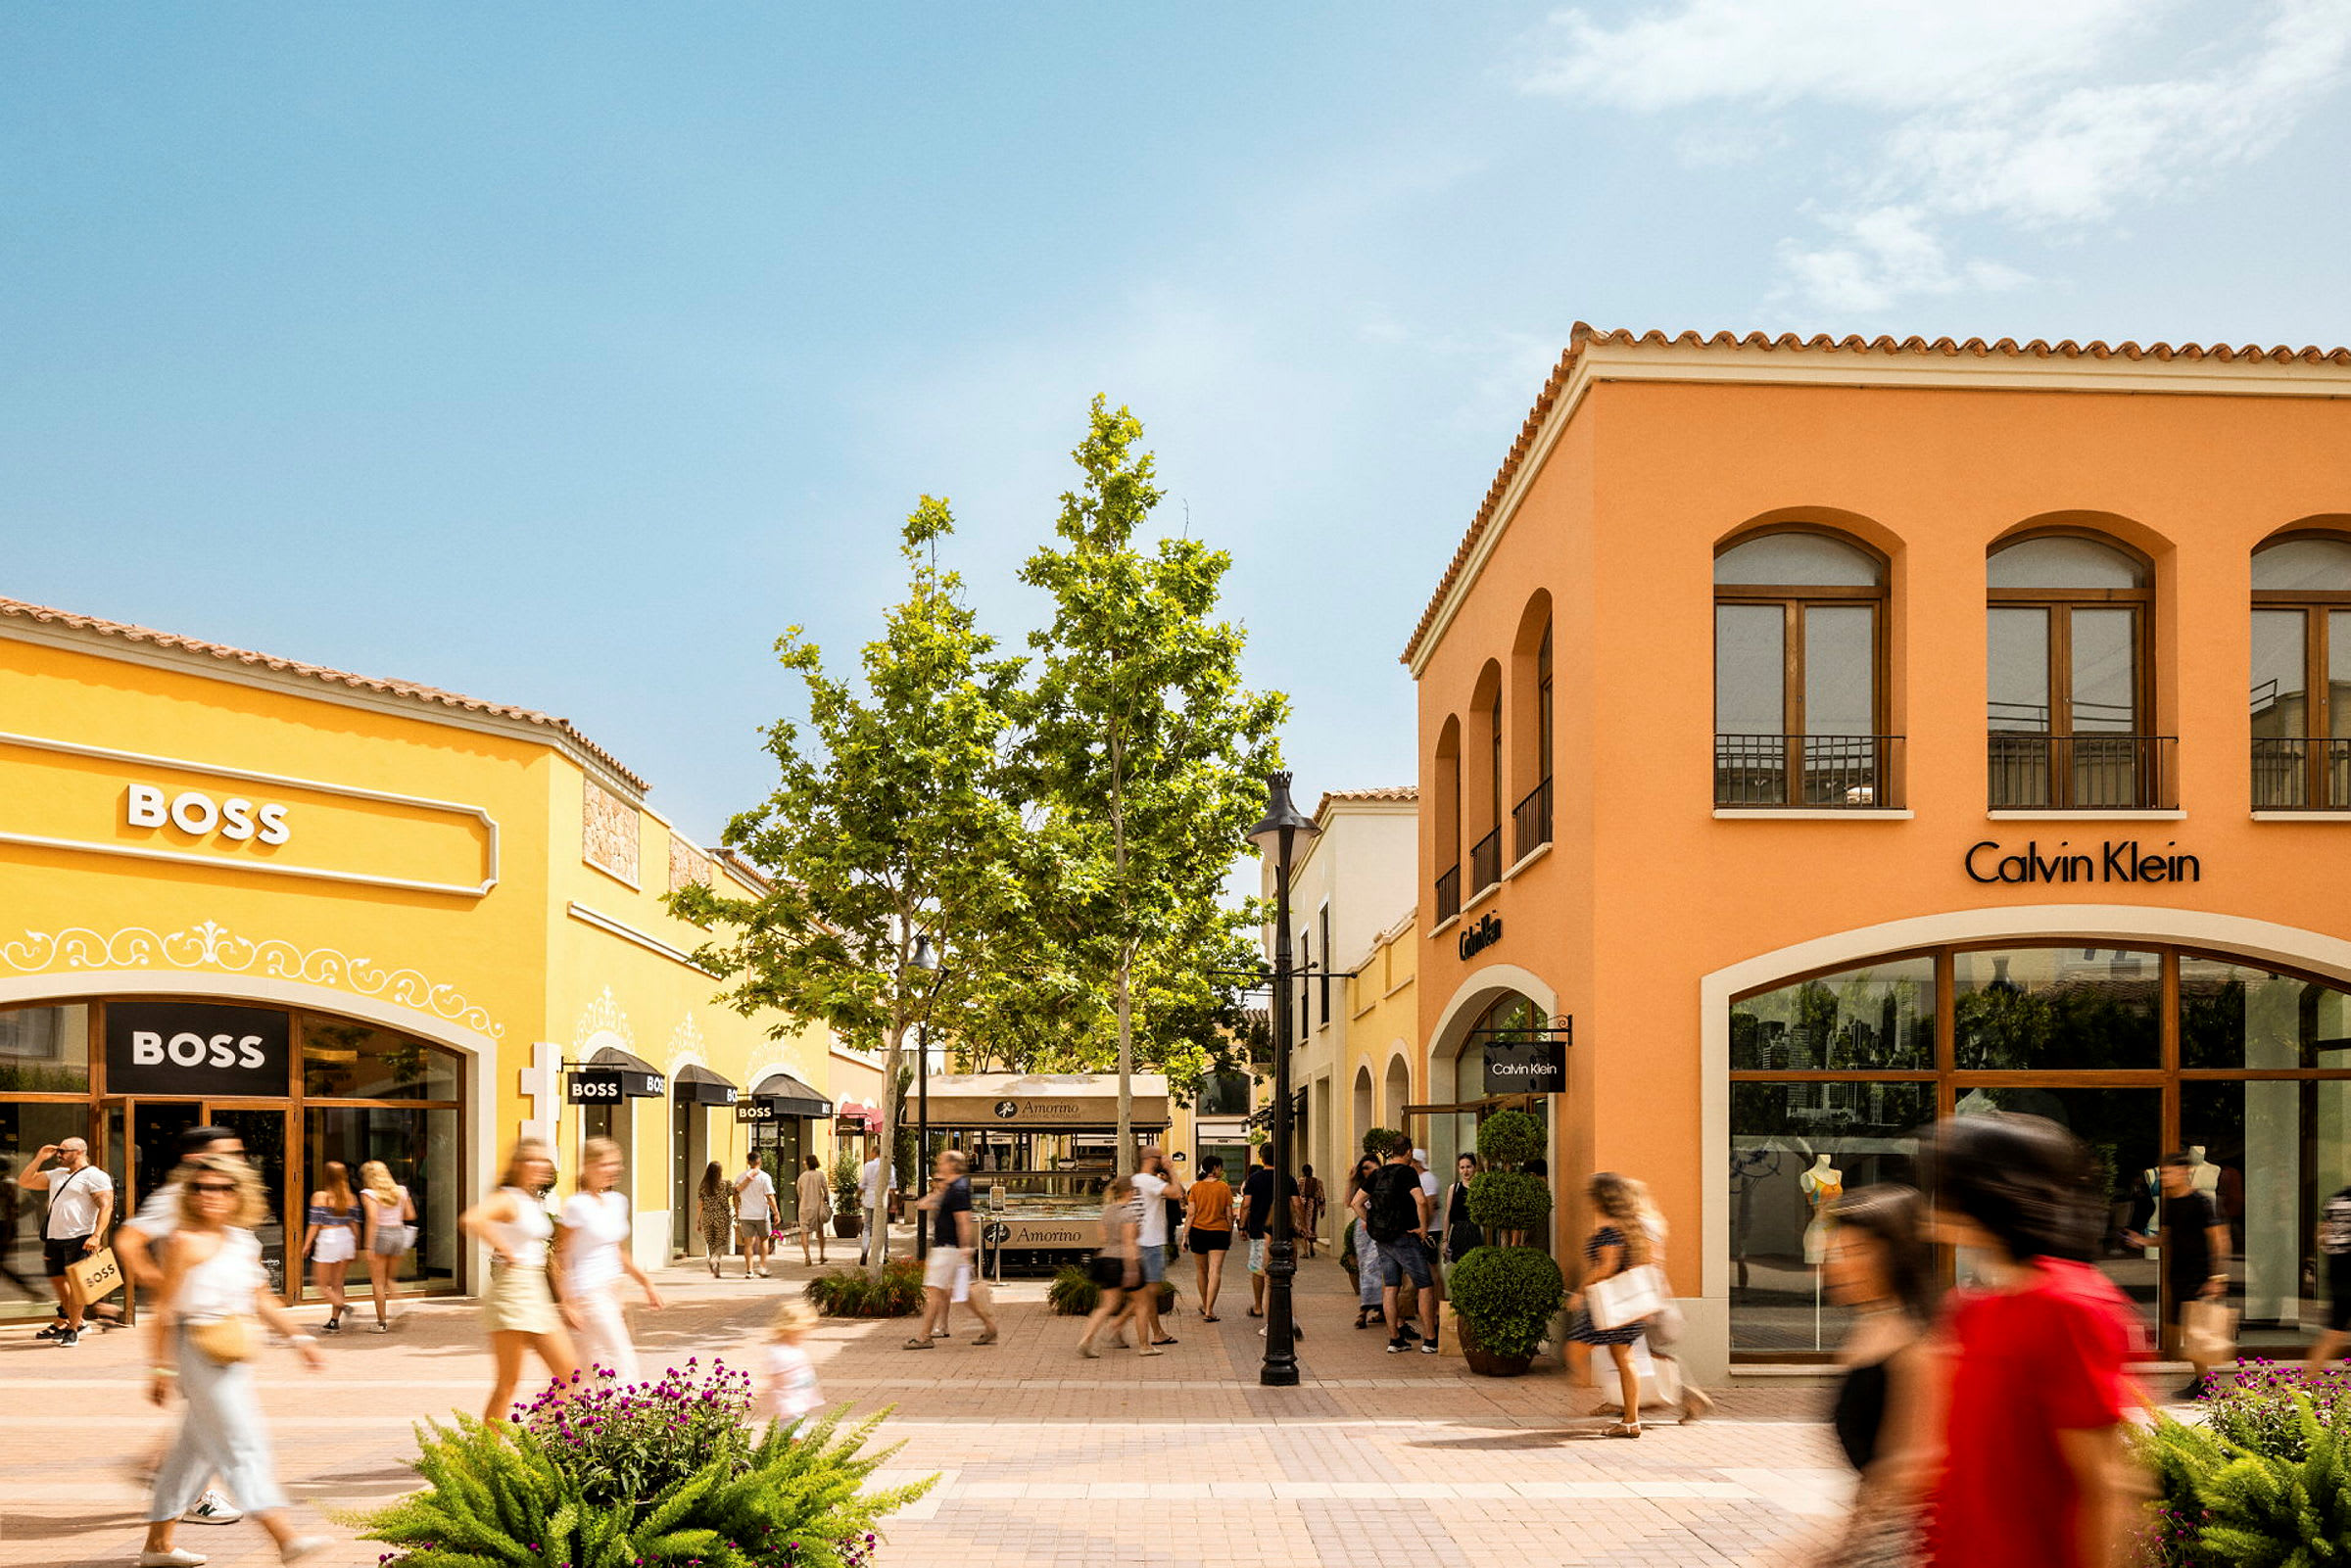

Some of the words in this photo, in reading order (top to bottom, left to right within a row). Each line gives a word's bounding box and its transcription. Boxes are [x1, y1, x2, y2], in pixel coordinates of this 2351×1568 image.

[127, 783, 291, 846] BOSS
[1965, 841, 2093, 883] Calvin
[2103, 841, 2200, 883] Klein
[133, 1031, 265, 1069] BOSS
[1492, 1063, 1529, 1075] Calvin
[1530, 1063, 1558, 1075] Klein
[572, 1083, 618, 1097] BOSS
[739, 1107, 772, 1117] BOSS
[1022, 1100, 1080, 1114] Amorino
[1017, 1227, 1081, 1242] Amorino
[86, 1263, 115, 1288] BOSS
